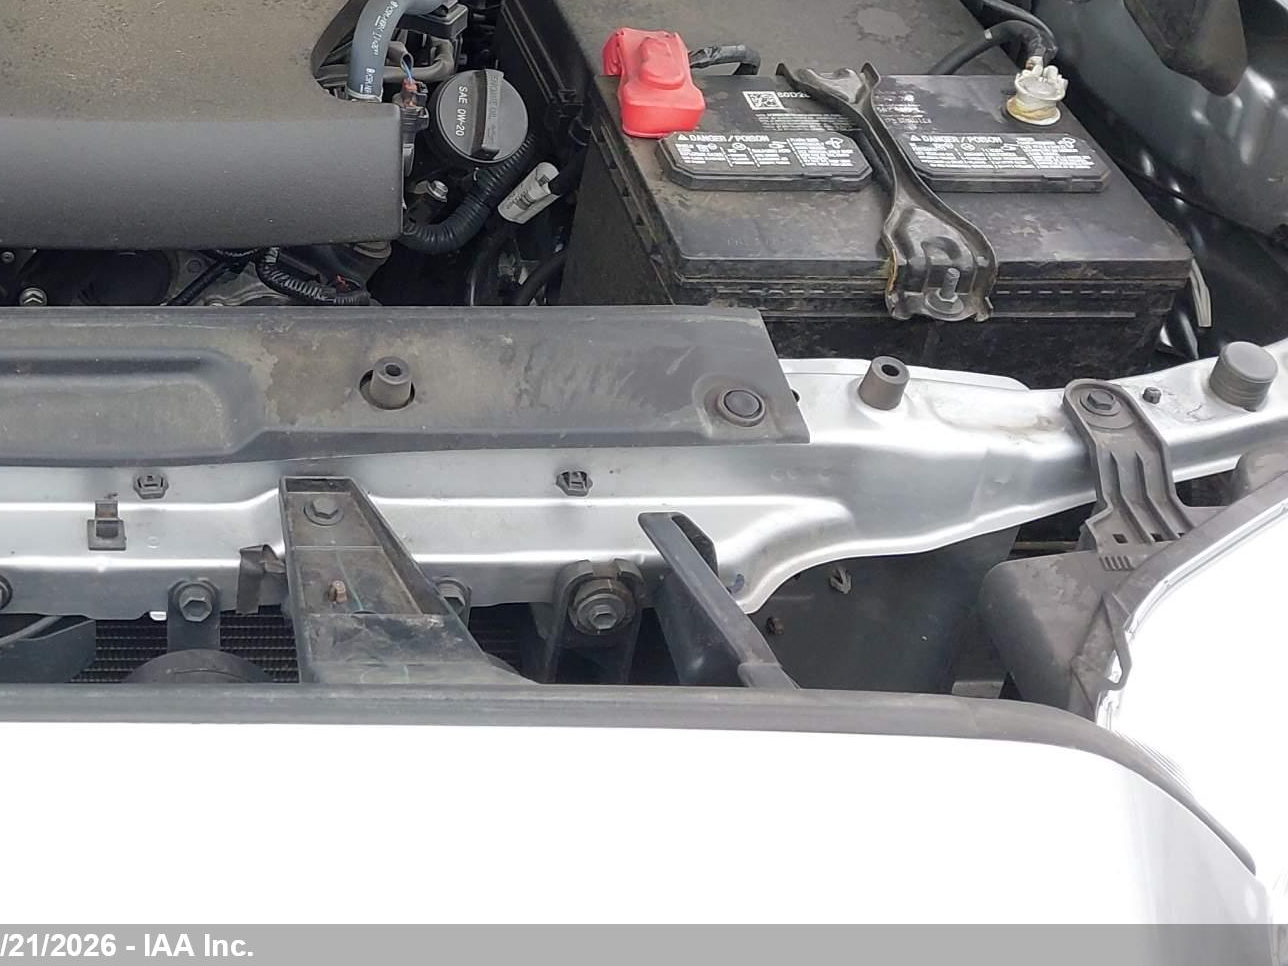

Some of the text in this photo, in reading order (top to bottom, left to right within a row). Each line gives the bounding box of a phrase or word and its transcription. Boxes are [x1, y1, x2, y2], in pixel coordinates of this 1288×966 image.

[455, 85, 469, 137] SAE 0W-20
[689, 134, 727, 142] DANGER
[734, 135, 770, 143] POISON
[967, 136, 1002, 144] POISON
